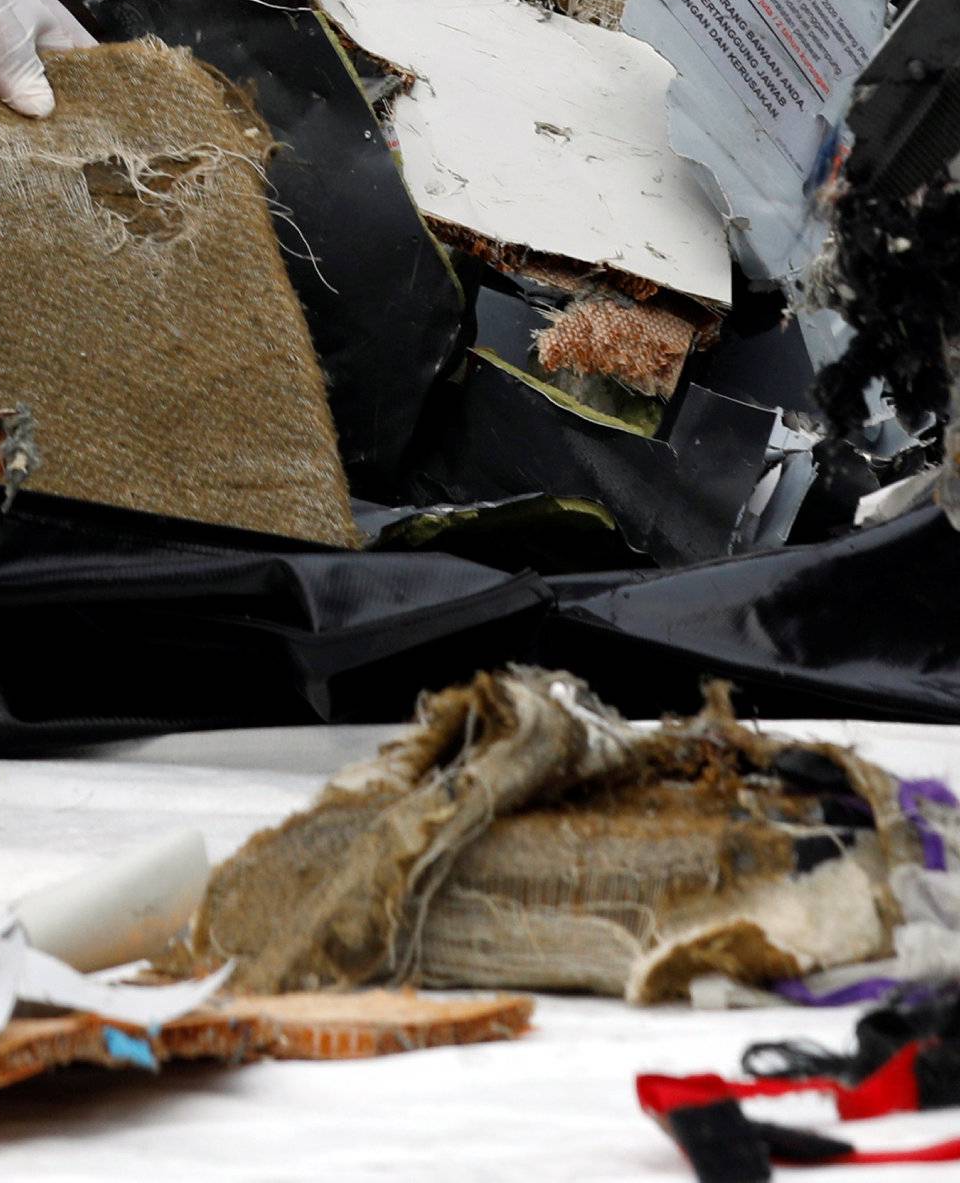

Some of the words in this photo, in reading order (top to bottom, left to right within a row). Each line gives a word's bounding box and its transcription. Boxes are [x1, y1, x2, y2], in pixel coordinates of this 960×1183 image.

[780, 27, 802, 53] tahun
[799, 3, 830, 40] genggam
[708, 28, 730, 53] DAN
[793, 28, 821, 62] pesawat
[808, 30, 843, 76] pelampung
[745, 30, 783, 78] BAWAAN
[780, 76, 809, 113] ANDA,
[756, 68, 789, 108] JAWAB
